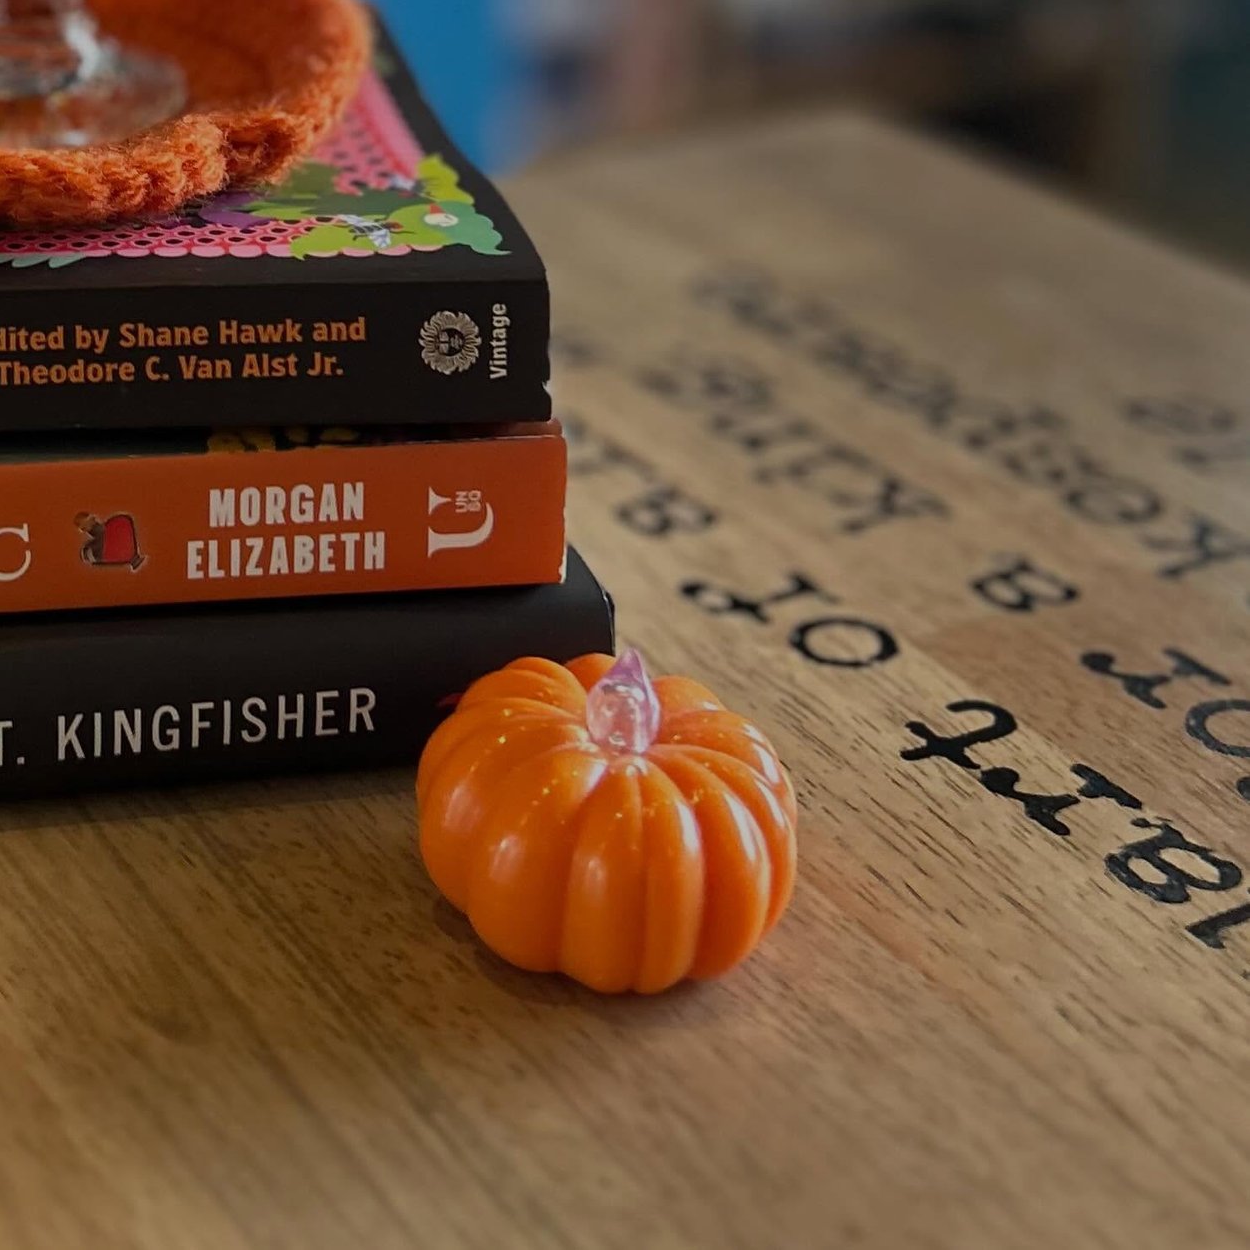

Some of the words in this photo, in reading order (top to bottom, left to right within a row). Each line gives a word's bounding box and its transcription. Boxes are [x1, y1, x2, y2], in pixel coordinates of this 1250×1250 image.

[75, 324, 110, 354] by
[118, 321, 209, 348] Shane
[219, 318, 303, 345] Hawk
[312, 316, 367, 343] and
[490, 303, 511, 379] Vintage
[145, 356, 170, 381] C.
[178, 354, 232, 381] Van
[241, 352, 298, 379] Alst
[306, 351, 345, 378] Jr.
[208, 481, 365, 528] MORGAN
[187, 530, 387, 580] ELIZABETH
[57, 686, 377, 762] KINGFISHER
